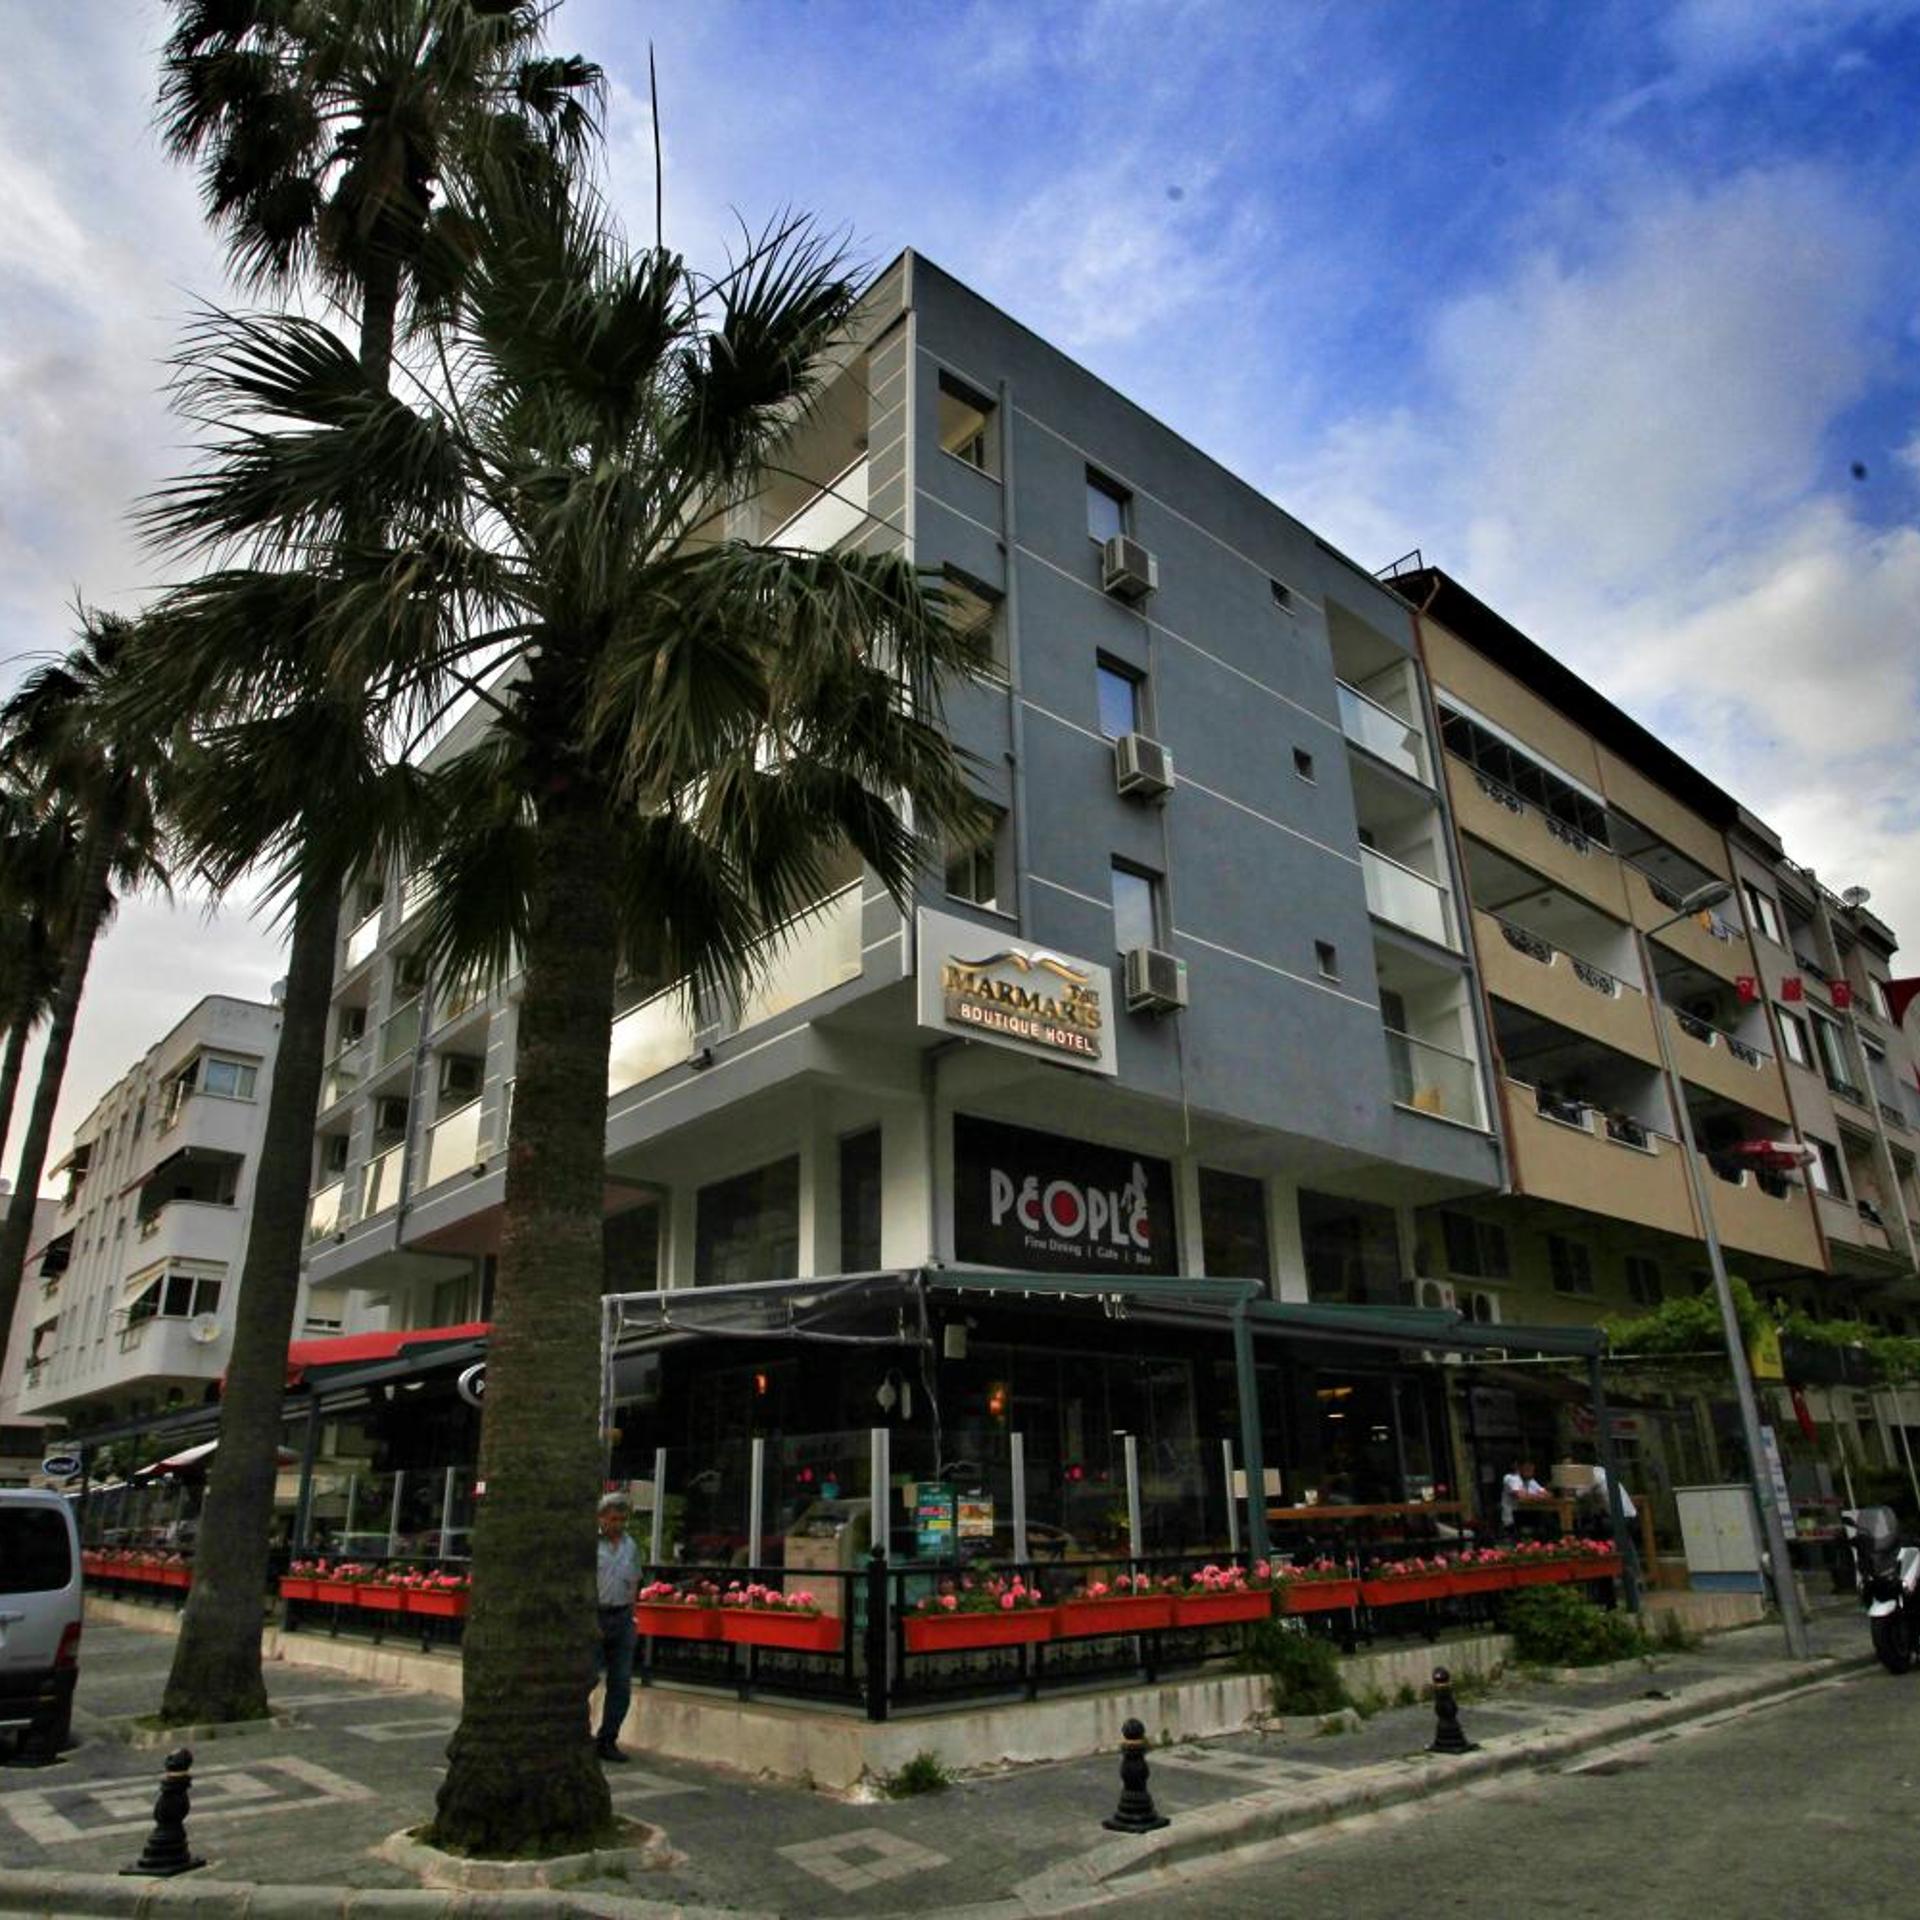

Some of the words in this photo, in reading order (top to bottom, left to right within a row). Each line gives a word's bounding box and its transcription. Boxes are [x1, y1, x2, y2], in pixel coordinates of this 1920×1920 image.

[960, 1003, 1041, 1038] BOUTIQUE
[1045, 1027, 1094, 1052] HOTEL
[990, 1166, 1151, 1249] PEOPLE
[1049, 1239, 1082, 1257] Dining
